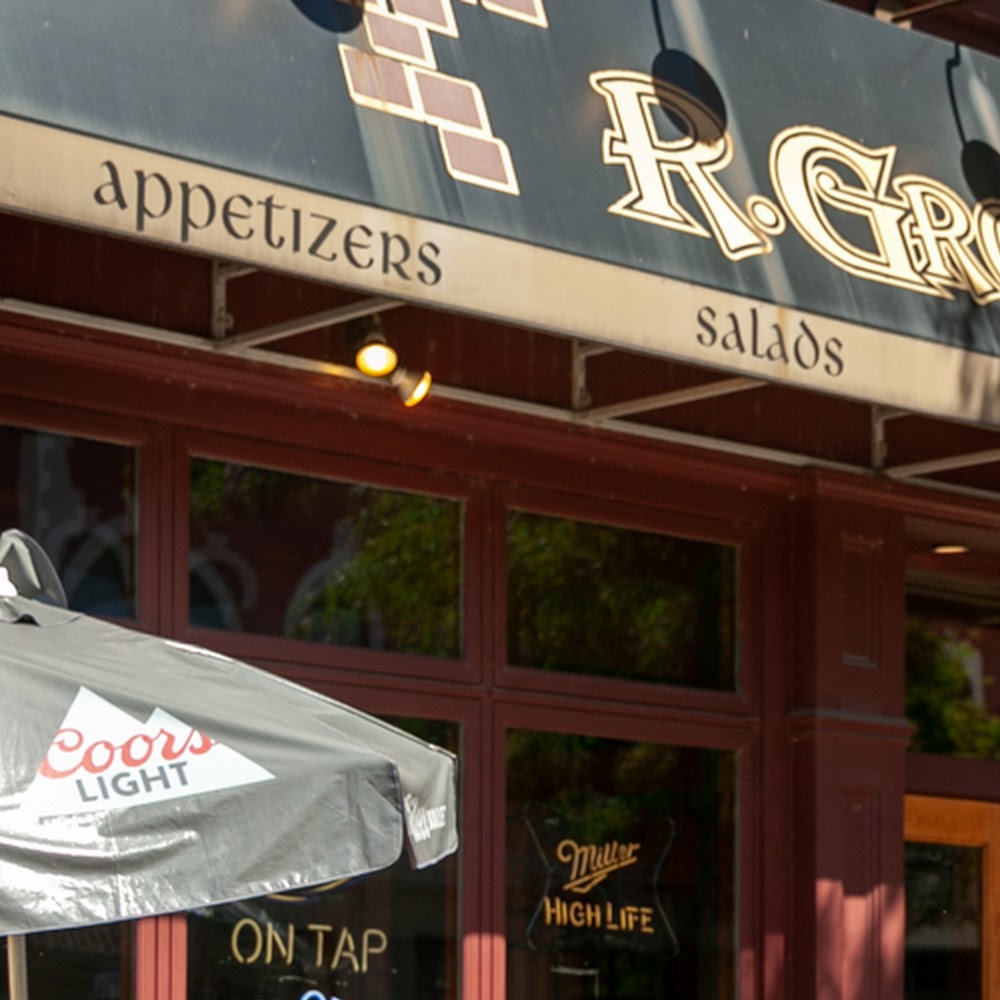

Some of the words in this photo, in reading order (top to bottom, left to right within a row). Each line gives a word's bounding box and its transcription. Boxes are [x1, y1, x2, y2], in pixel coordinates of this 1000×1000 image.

[588, 69, 786, 262] R.
[696, 305, 844, 377] salads
[39, 728, 221, 779] Coors
[75, 761, 190, 803] LIGHT
[556, 838, 641, 882] Miller
[544, 896, 602, 929] HIGH
[606, 901, 655, 934] LIFE
[230, 917, 296, 966] ON
[307, 922, 389, 974] TAP
